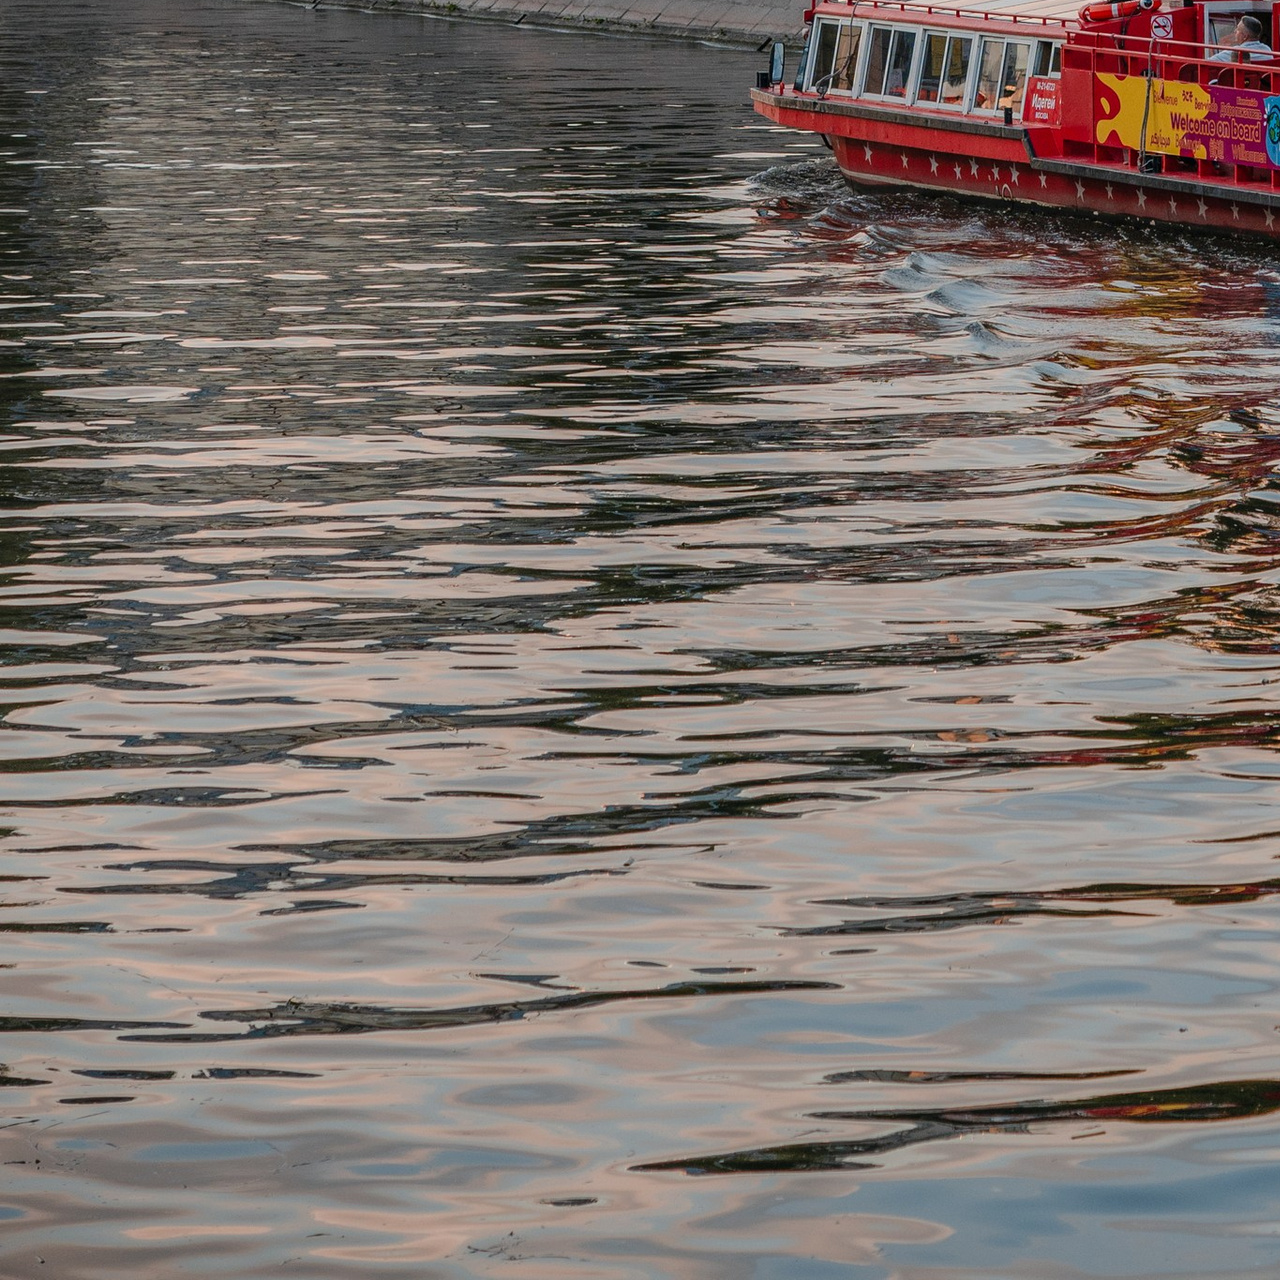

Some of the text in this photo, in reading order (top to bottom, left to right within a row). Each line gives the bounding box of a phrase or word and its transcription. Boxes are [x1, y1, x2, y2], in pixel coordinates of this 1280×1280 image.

[1032, 94, 1056, 110] Идегей
[1170, 112, 1261, 142] Welcome on board
